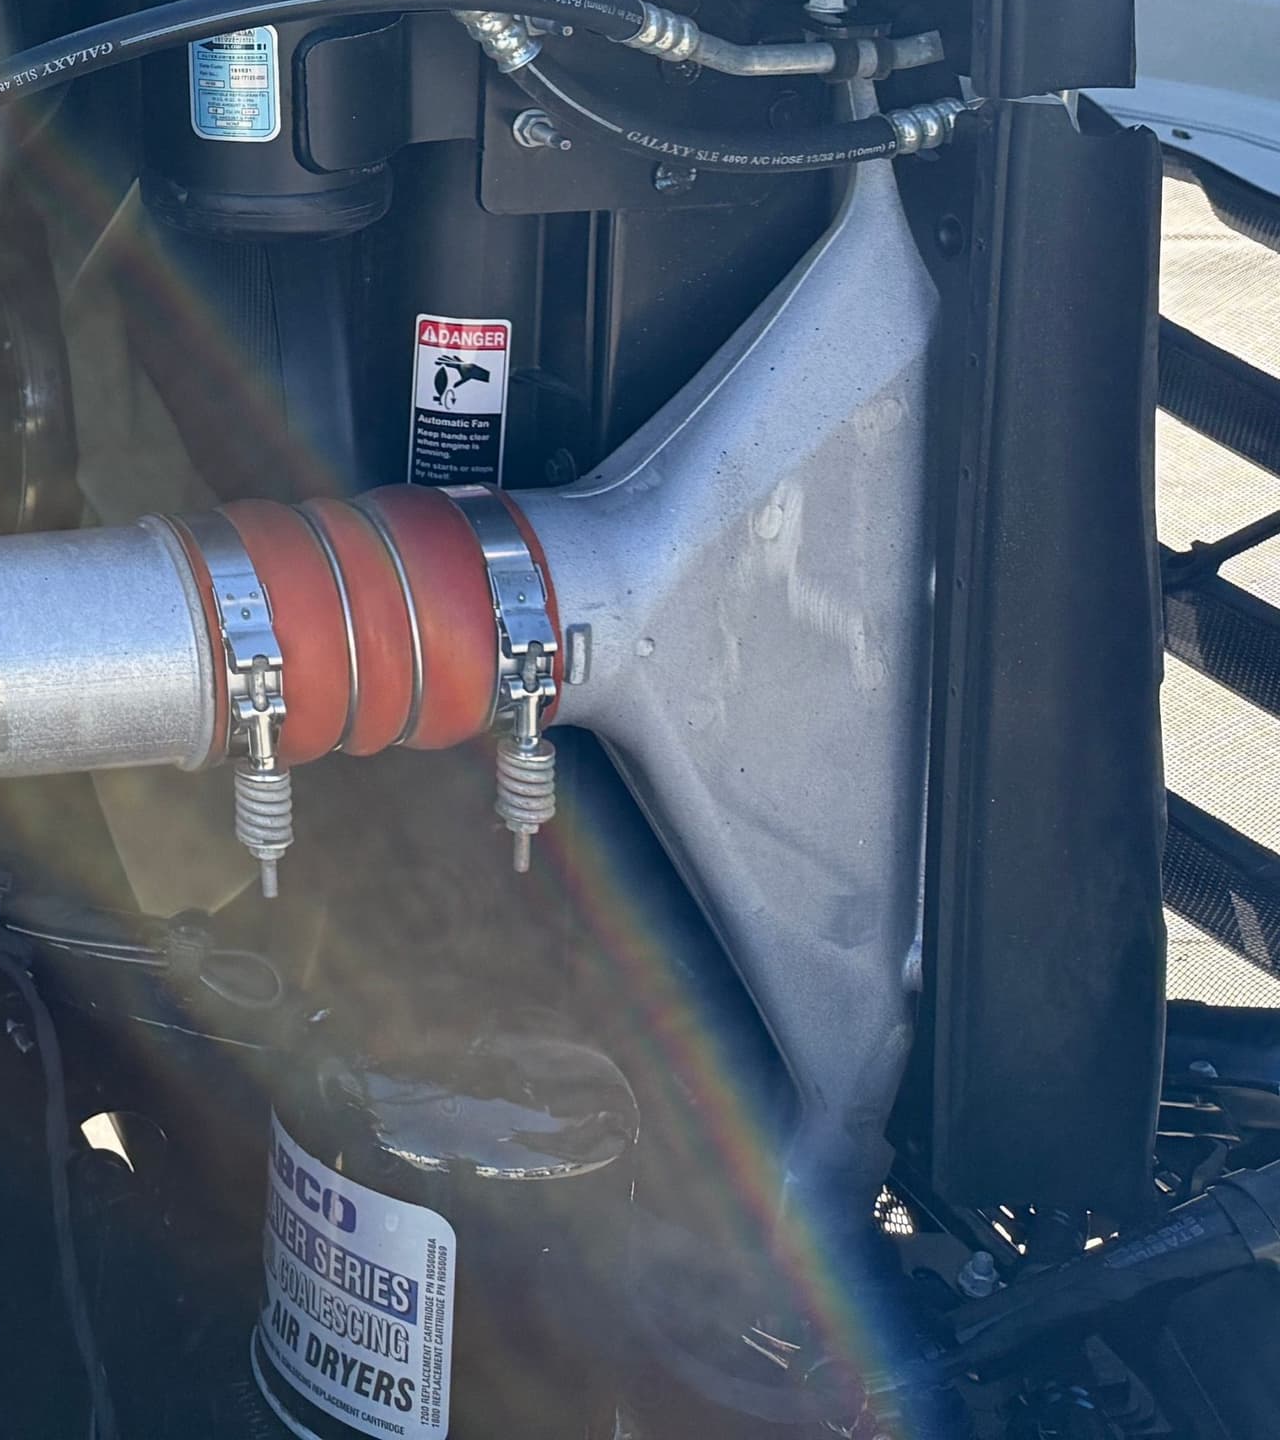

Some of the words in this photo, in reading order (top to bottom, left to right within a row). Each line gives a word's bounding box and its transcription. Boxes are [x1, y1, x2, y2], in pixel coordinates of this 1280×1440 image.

[42, 41, 113, 77] GALAXY
[15, 68, 38, 86] SLE
[626, 130, 694, 158] GALAXY
[696, 150, 718, 162] SLE
[751, 155, 769, 165] A/C
[772, 155, 803, 165] HOSE
[847, 144, 886, 161] (10mm)
[439, 329, 505, 346] DANGER
[417, 428, 439, 440] Keep
[441, 431, 468, 441] hands
[470, 432, 490, 441] clear
[418, 414, 470, 428] Automatic
[472, 419, 490, 428] Fan
[417, 438, 440, 449] when
[441, 441, 470, 451] engine
[416, 459, 431, 469] Fan
[314, 1231, 410, 1315] SERIES
[425, 1282, 435, 1294] PN
[279, 1252, 410, 1364] COALESCING
[423, 1296, 434, 1343] CARTRIDGE
[434, 1298, 445, 1345] CARTRIDGE
[271, 1299, 300, 1353] AIR
[305, 1330, 415, 1412] DRYERS
[421, 1344, 432, 1405] REPLACEMENT
[432, 1347, 443, 1407] REPLACEMENT
[360, 1410, 406, 1436] CARTRIDGE
[421, 1406, 430, 1426] 1200
